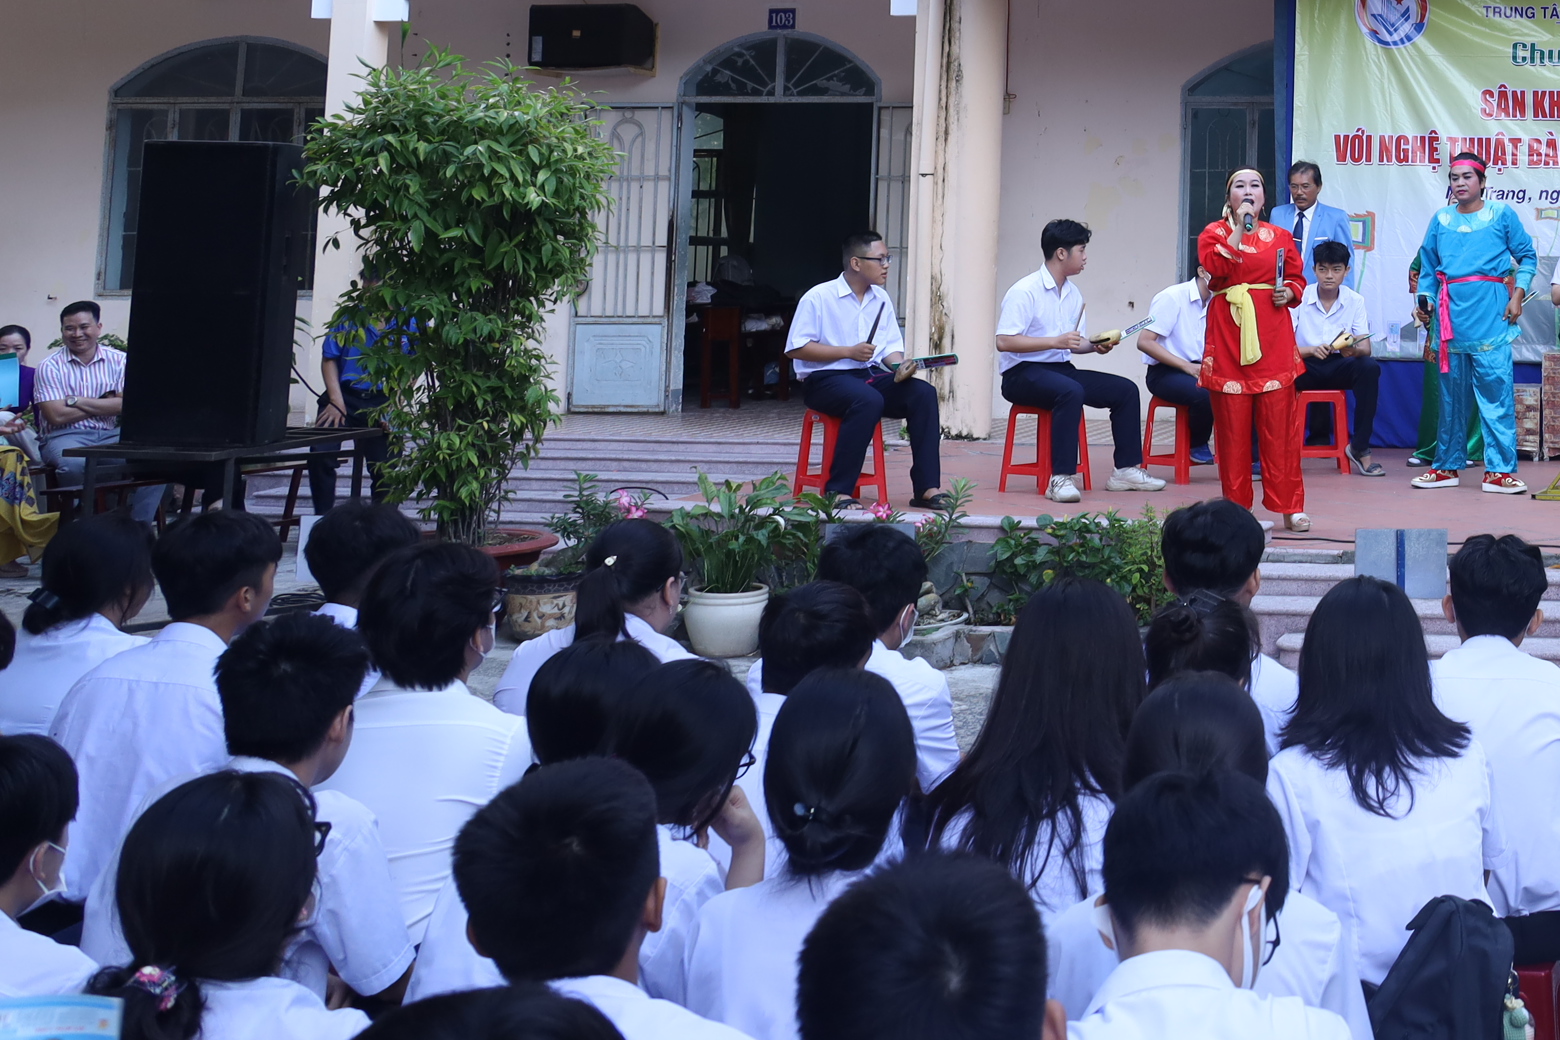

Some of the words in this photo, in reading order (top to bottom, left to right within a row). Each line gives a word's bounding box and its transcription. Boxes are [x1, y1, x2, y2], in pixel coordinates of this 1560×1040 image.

[771, 12, 793, 26] 103
[1483, 6, 1535, 19] TRUNG
[1480, 83, 1526, 120] SÂN
[1334, 127, 1373, 165] VỚI
[1378, 130, 1442, 172] NGHỆ
